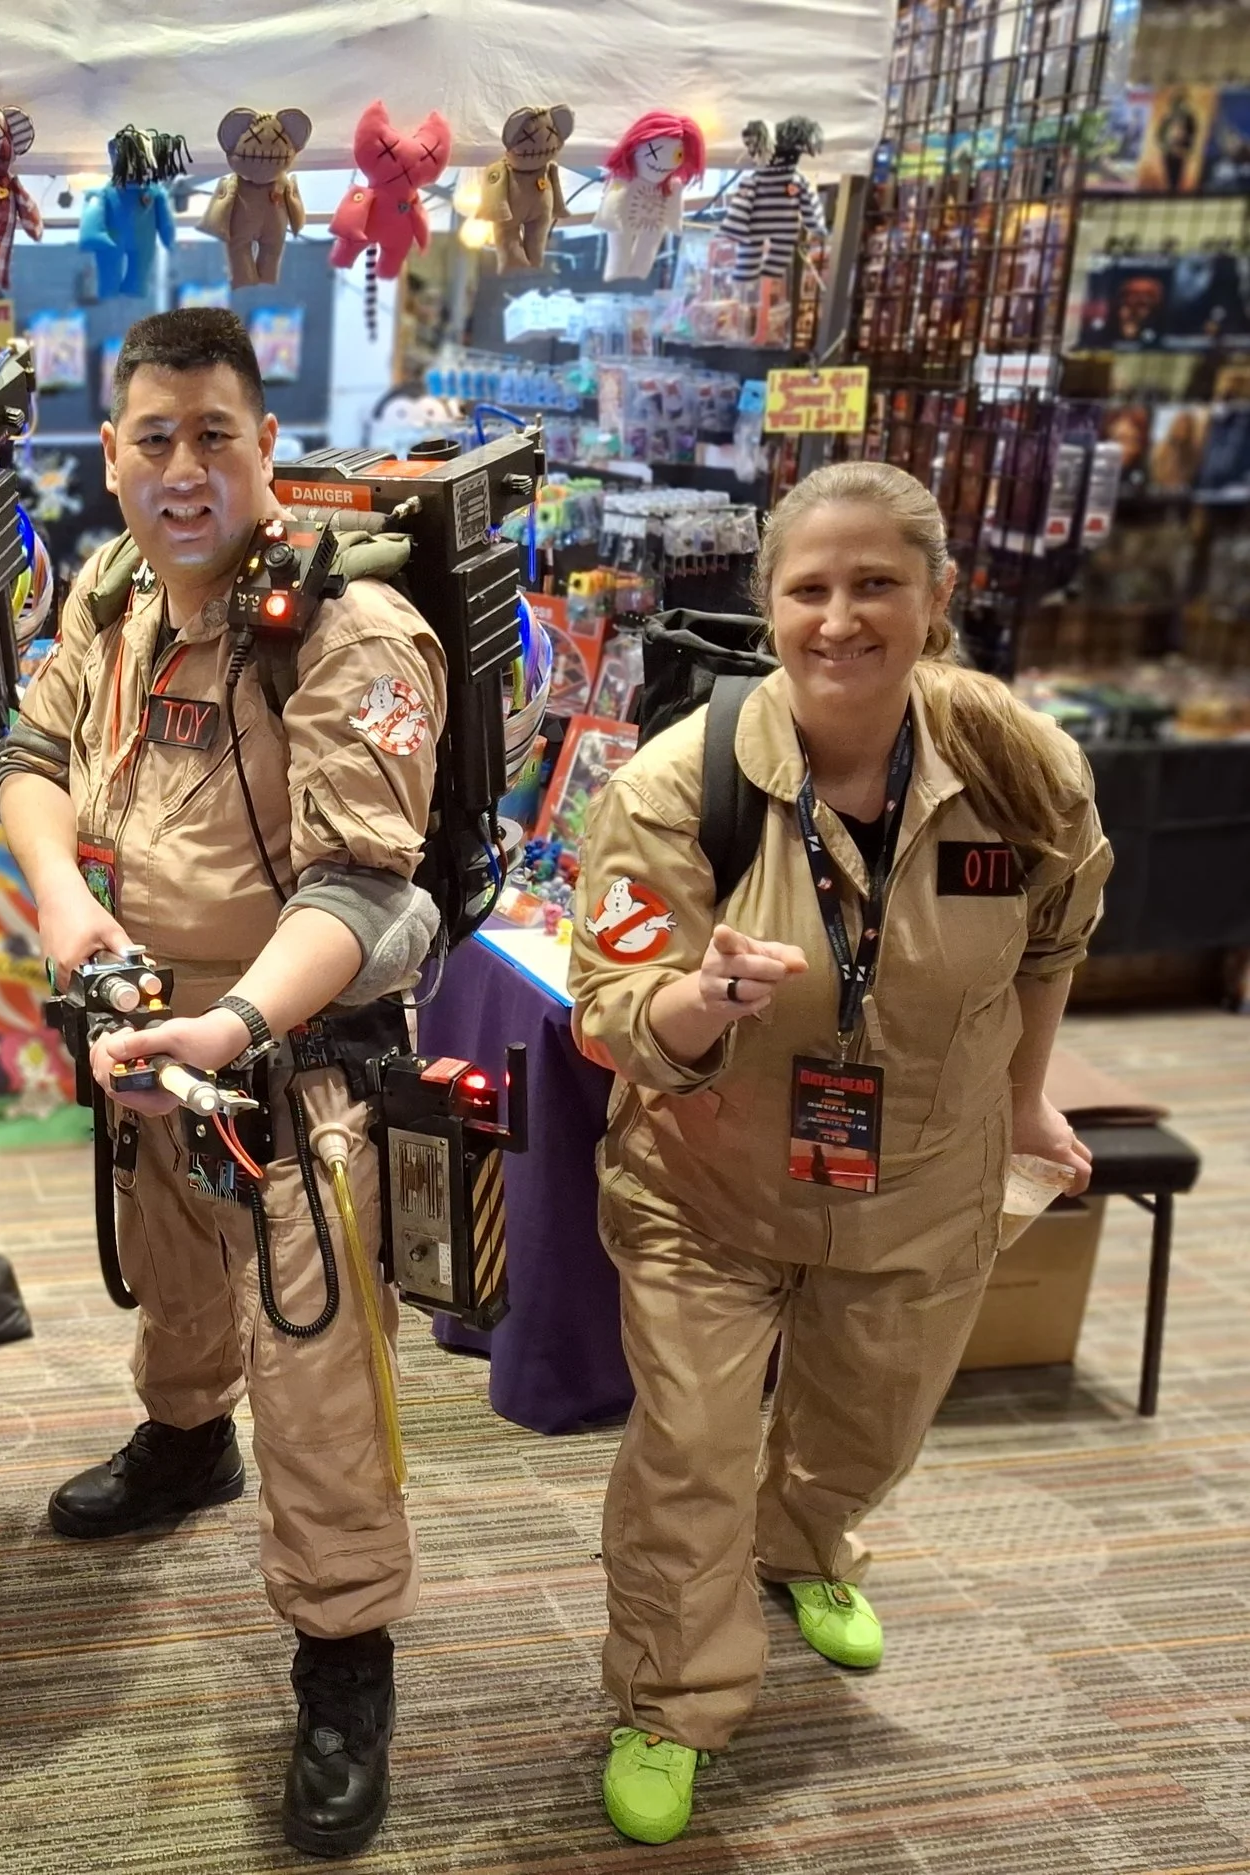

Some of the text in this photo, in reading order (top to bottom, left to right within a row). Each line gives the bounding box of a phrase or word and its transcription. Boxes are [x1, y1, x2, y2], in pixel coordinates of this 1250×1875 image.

[292, 486, 353, 503] DANGER
[162, 700, 211, 744] TOY
[964, 849, 1012, 889] OTT
